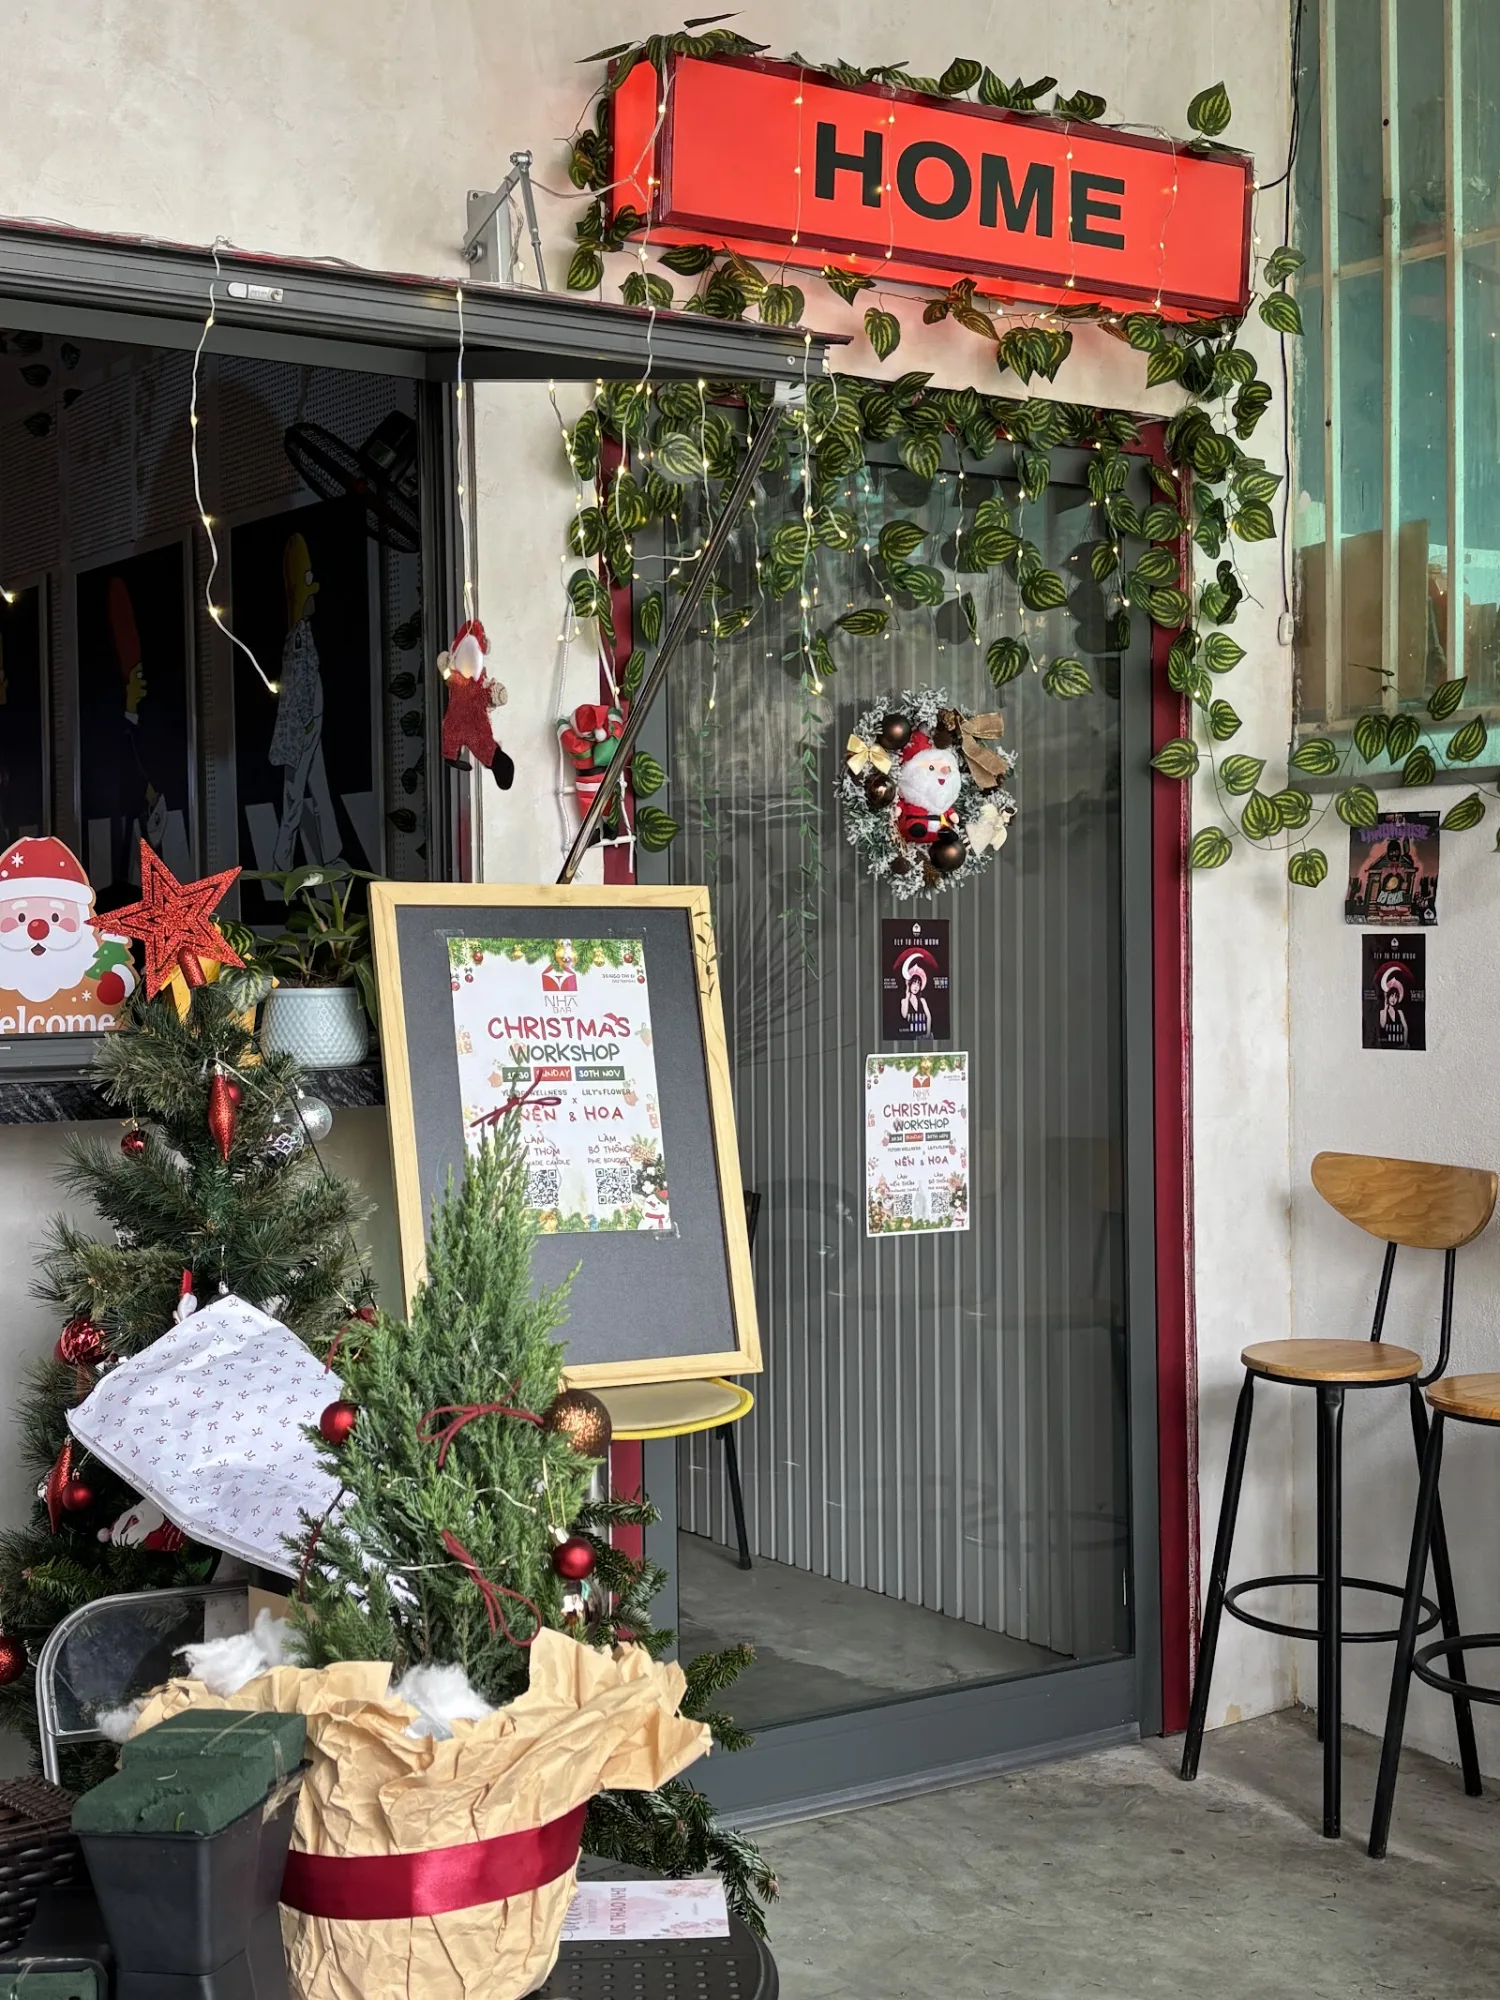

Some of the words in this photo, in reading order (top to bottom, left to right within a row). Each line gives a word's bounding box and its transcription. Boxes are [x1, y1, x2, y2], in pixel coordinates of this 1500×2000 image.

[815, 121, 1125, 250] HOME
[487, 1015, 631, 1041] CHRISTMAS
[509, 1043, 620, 1063] WORKSHOP
[578, 1069, 600, 1078] 30TH
[602, 1069, 621, 1078] NOV
[603, 1088, 631, 1096] FLOWER
[569, 1111, 577, 1122] &
[584, 1106, 624, 1120] HOA
[883, 1101, 956, 1118] CHRISTMAS
[892, 1118, 949, 1132] WORKSHOP
[928, 1155, 949, 1165] HOA
